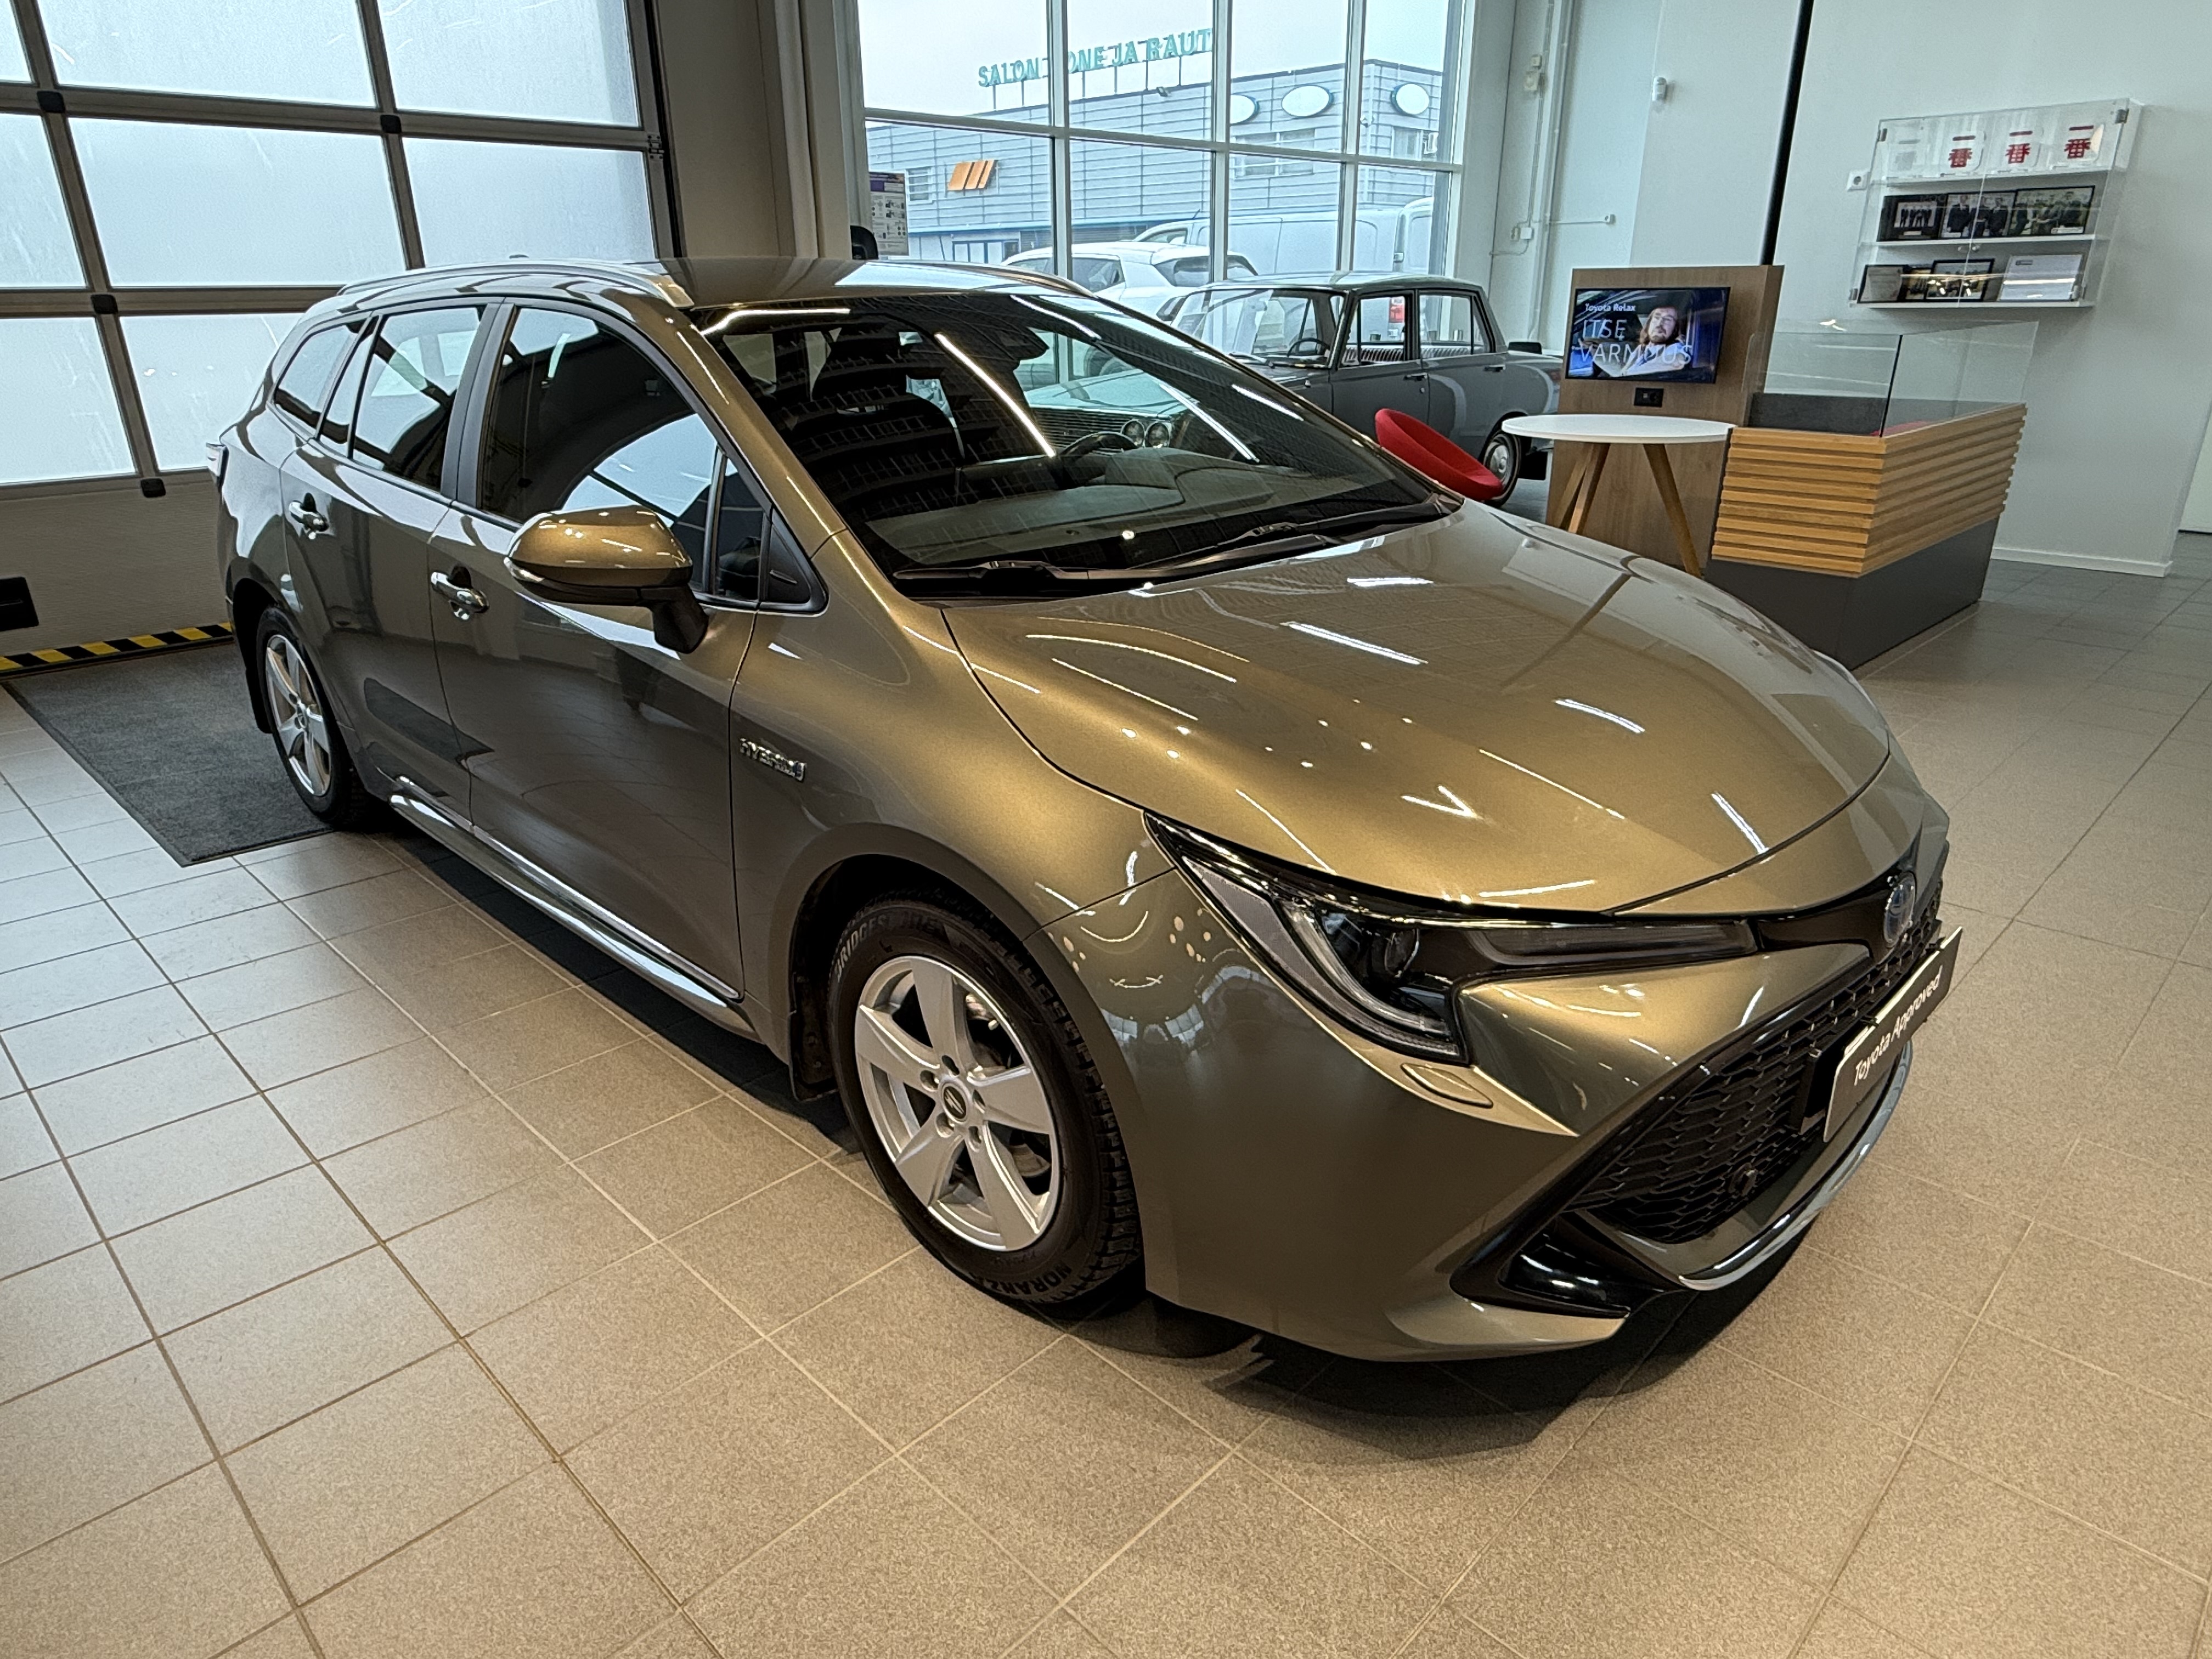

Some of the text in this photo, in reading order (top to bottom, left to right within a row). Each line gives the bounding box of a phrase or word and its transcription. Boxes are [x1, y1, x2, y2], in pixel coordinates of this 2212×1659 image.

[978, 27, 1213, 87] SALON ONE JA RAUT
[1585, 303, 1636, 312] Toyota Relax
[1582, 319, 1627, 340] ITSE
[1853, 964, 1943, 1086] Toyota Approved
